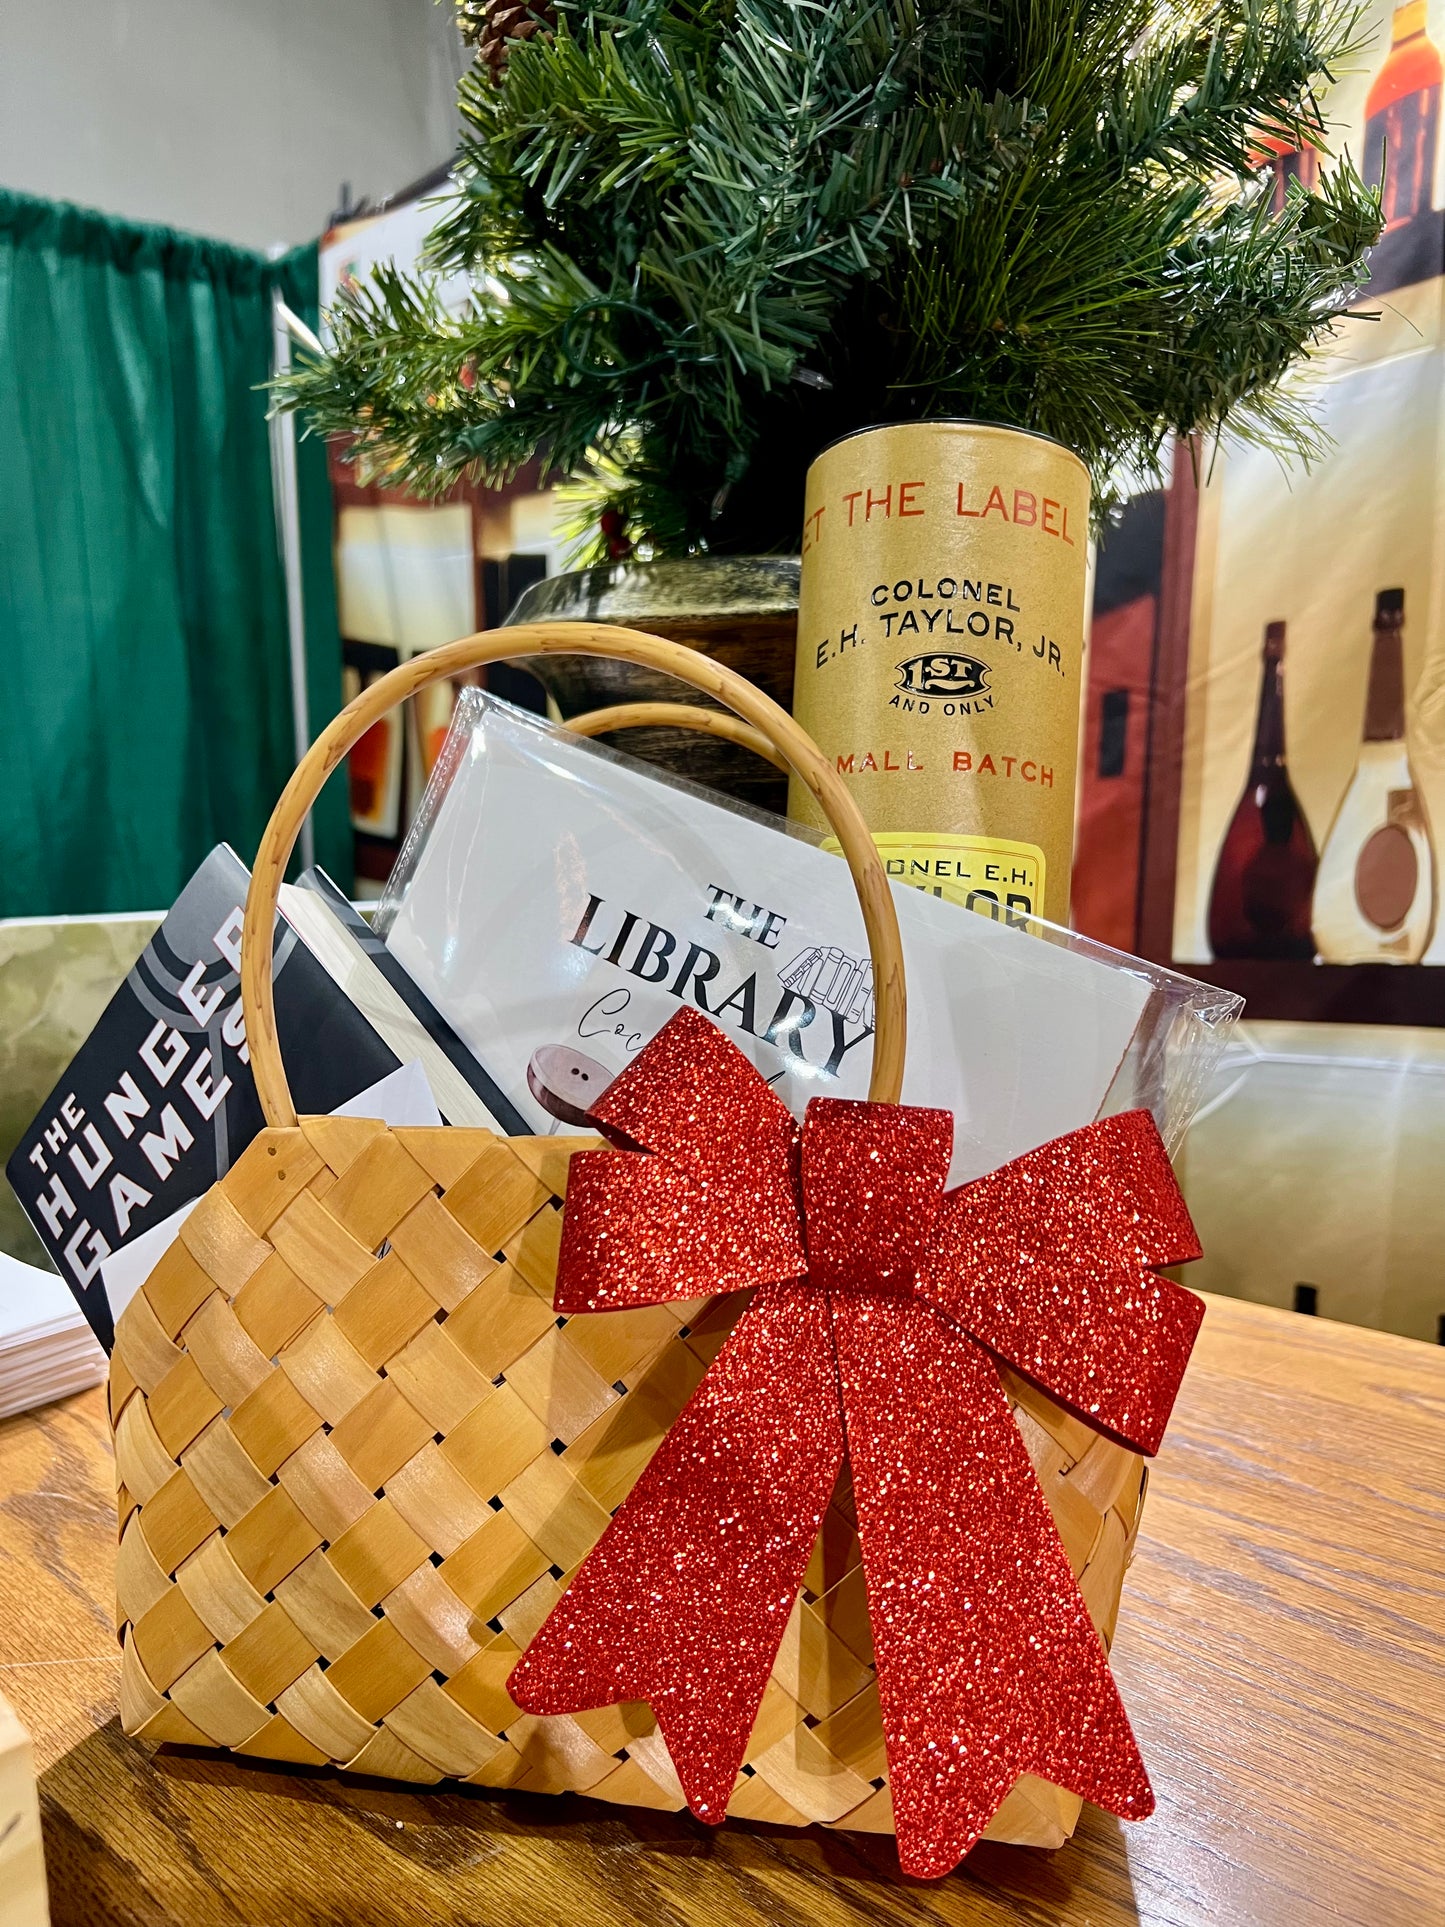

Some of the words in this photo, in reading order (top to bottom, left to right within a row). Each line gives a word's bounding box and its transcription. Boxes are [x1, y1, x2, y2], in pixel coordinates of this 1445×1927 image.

[843, 482, 925, 527] THE
[956, 482, 1074, 546] LABEL
[871, 577, 1021, 613] COLONEL
[816, 624, 866, 669] E.H.
[880, 608, 1023, 652] TAYLOR,
[1032, 635, 1066, 677] JR.
[906, 658, 972, 691] 1ST
[889, 694, 931, 715] AND
[943, 694, 996, 717] ONLY
[836, 750, 924, 776] MALL
[952, 751, 1054, 789] BATCH
[886, 859, 971, 878] ONEL
[985, 864, 1034, 887] E.H.
[704, 884, 788, 949] THE
[569, 893, 875, 1078] LIBRARY
[29, 1092, 86, 1172] THE
